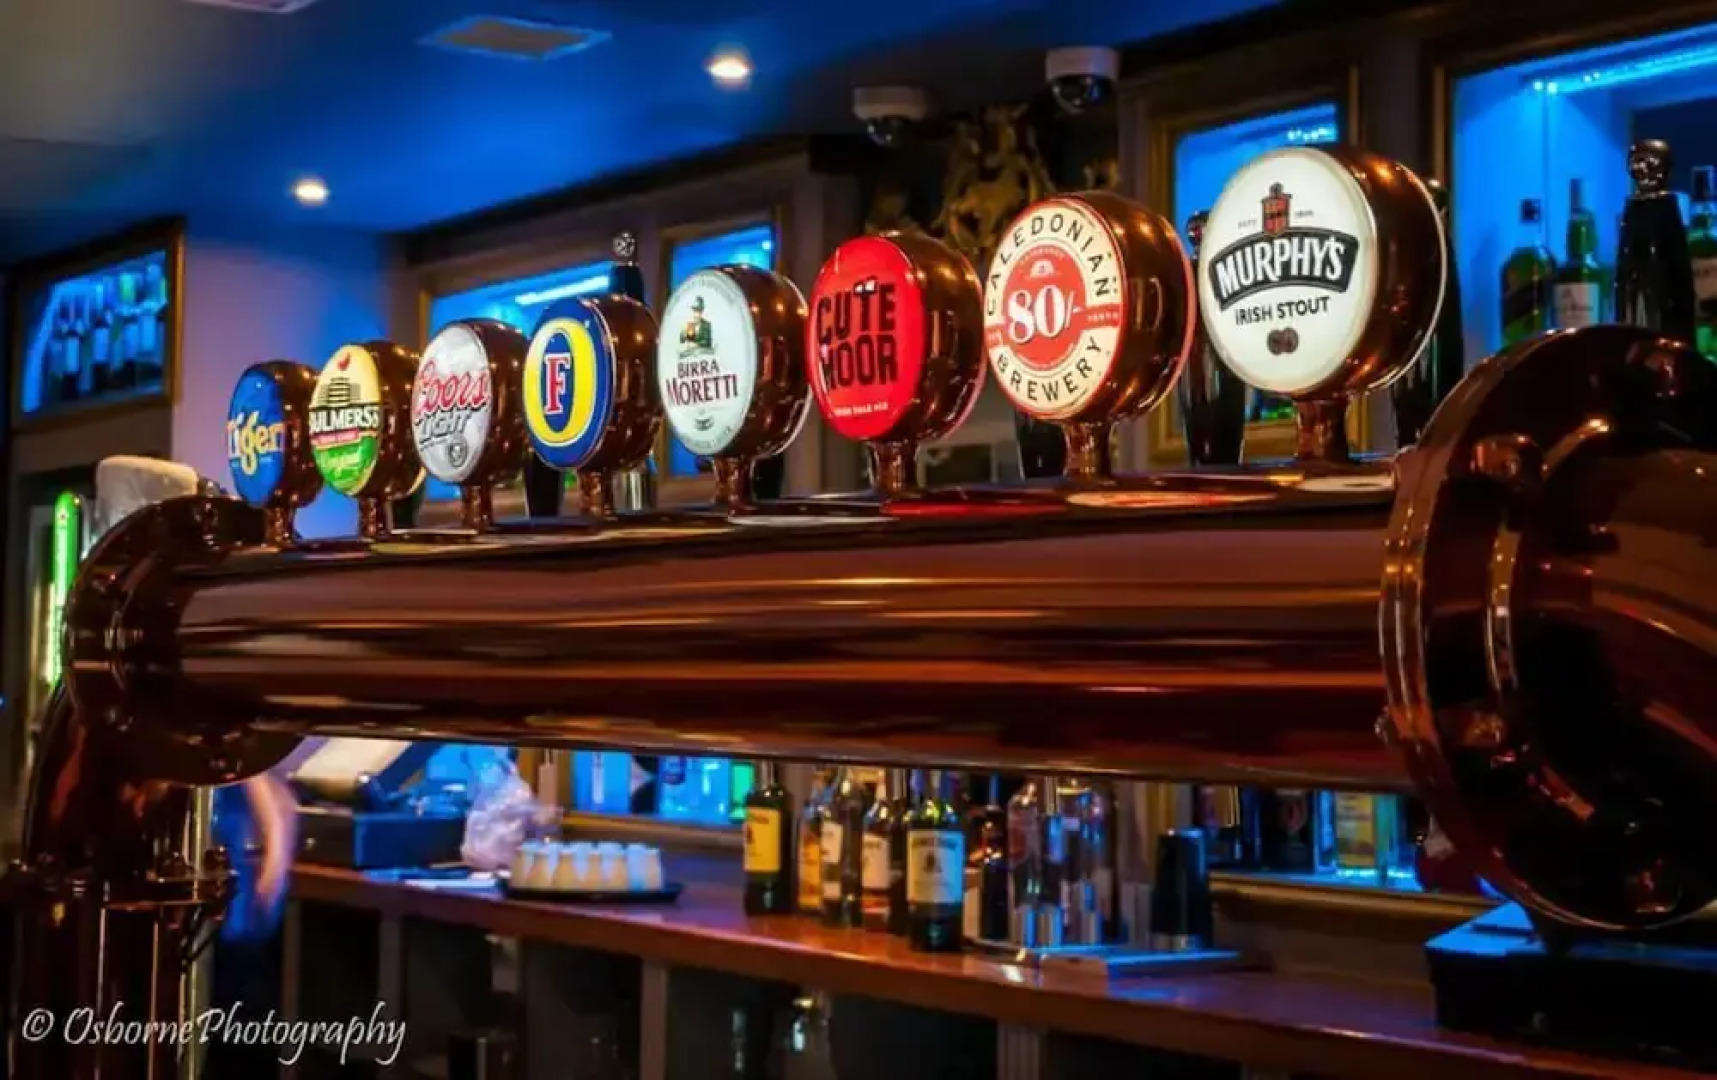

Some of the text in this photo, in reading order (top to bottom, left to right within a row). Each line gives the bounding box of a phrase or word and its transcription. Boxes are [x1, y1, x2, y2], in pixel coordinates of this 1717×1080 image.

[986, 213, 1111, 316] CALEDONIAN
[1215, 236, 1345, 299] MURPHY'S
[817, 282, 896, 346] CUTE
[1235, 296, 1330, 325] IRISH STOUT
[412, 359, 491, 416] Coors
[546, 353, 571, 414] F
[666, 373, 738, 406] MORETTI
[677, 359, 720, 378] BIRRA
[997, 336, 1101, 401] BREWERY
